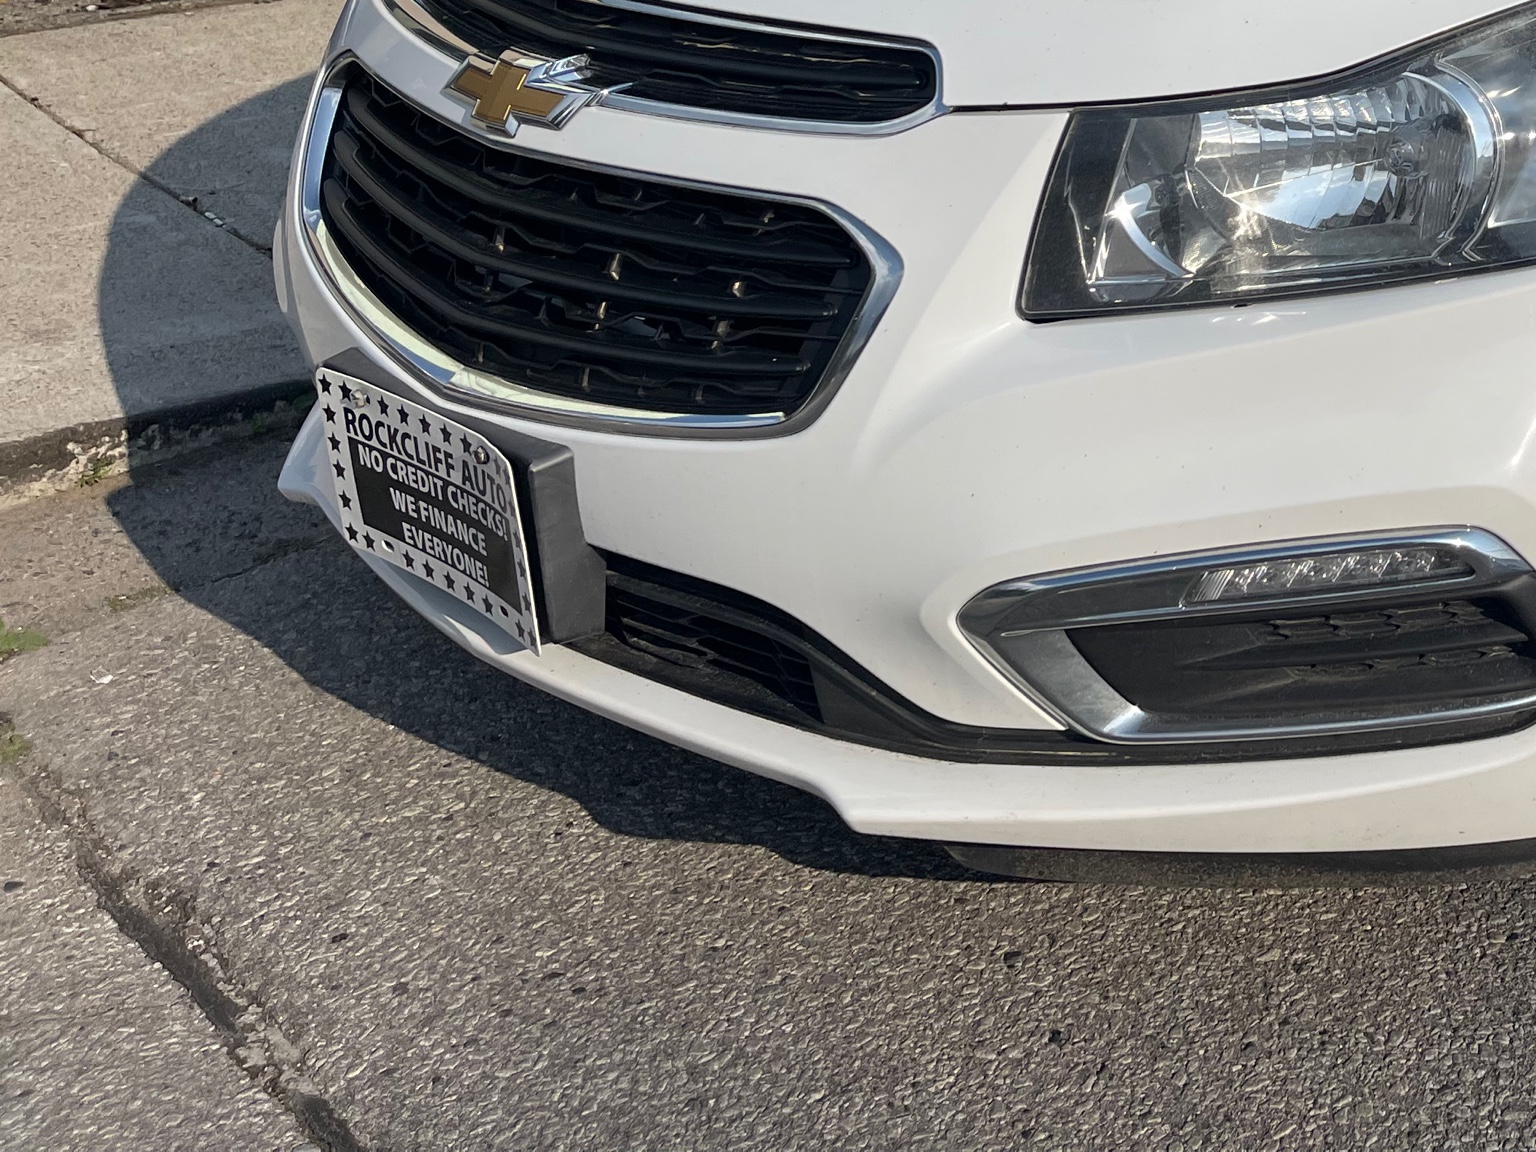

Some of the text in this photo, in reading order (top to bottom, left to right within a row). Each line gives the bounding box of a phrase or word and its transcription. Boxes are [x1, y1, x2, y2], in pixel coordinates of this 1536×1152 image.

[343, 406, 508, 514] ROCKCLIFF AUTO
[357, 443, 508, 541] NO CREDIT CHECKS!
[389, 487, 488, 557] WE FINANCE
[402, 521, 490, 588] EVERYONE!
